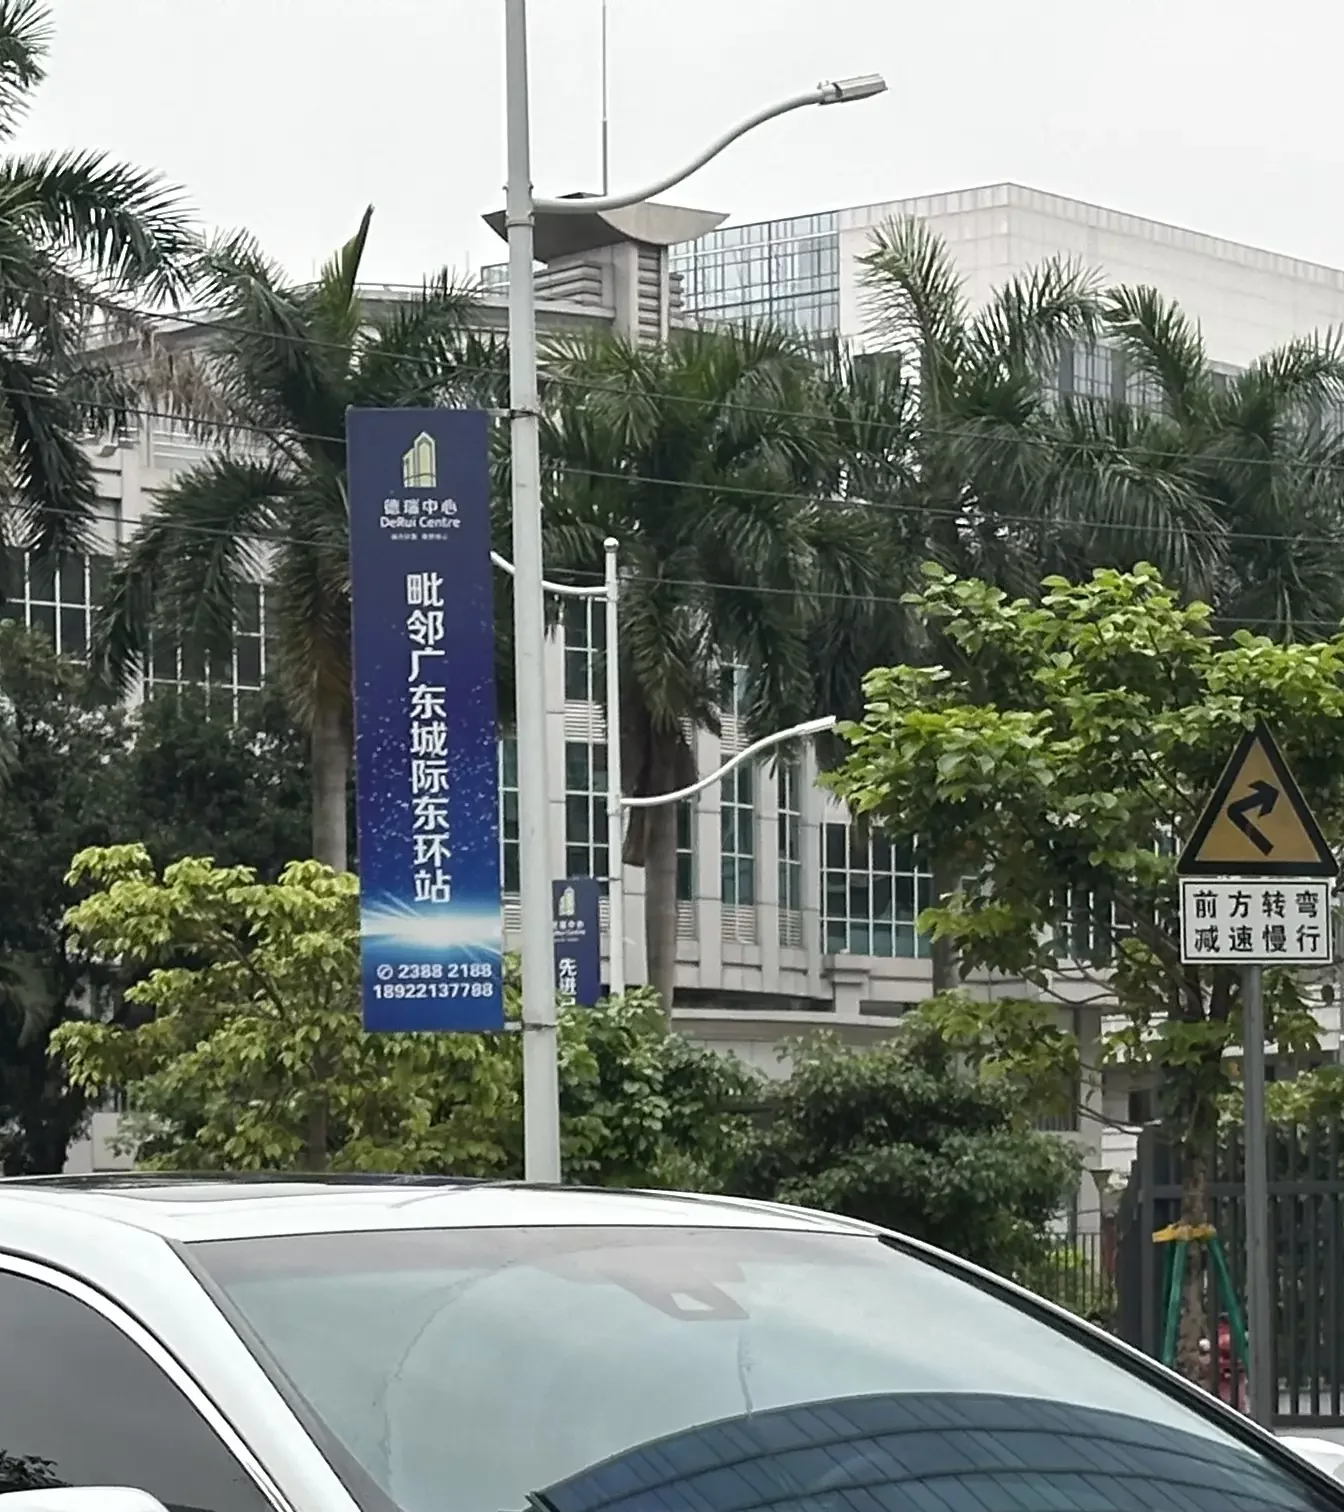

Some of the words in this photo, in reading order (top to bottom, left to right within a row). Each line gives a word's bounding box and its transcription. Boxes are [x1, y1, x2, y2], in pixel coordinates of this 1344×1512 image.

[380, 516, 417, 528] DeRui
[419, 516, 461, 528] Centre
[406, 572, 452, 903] 毗邻广东城际东环站
[1193, 890, 1320, 919] 前方转弯
[1194, 924, 1321, 953] 减速慢行
[398, 964, 443, 979] 2388
[448, 963, 492, 978] 2188
[373, 982, 494, 999] 18922137788
